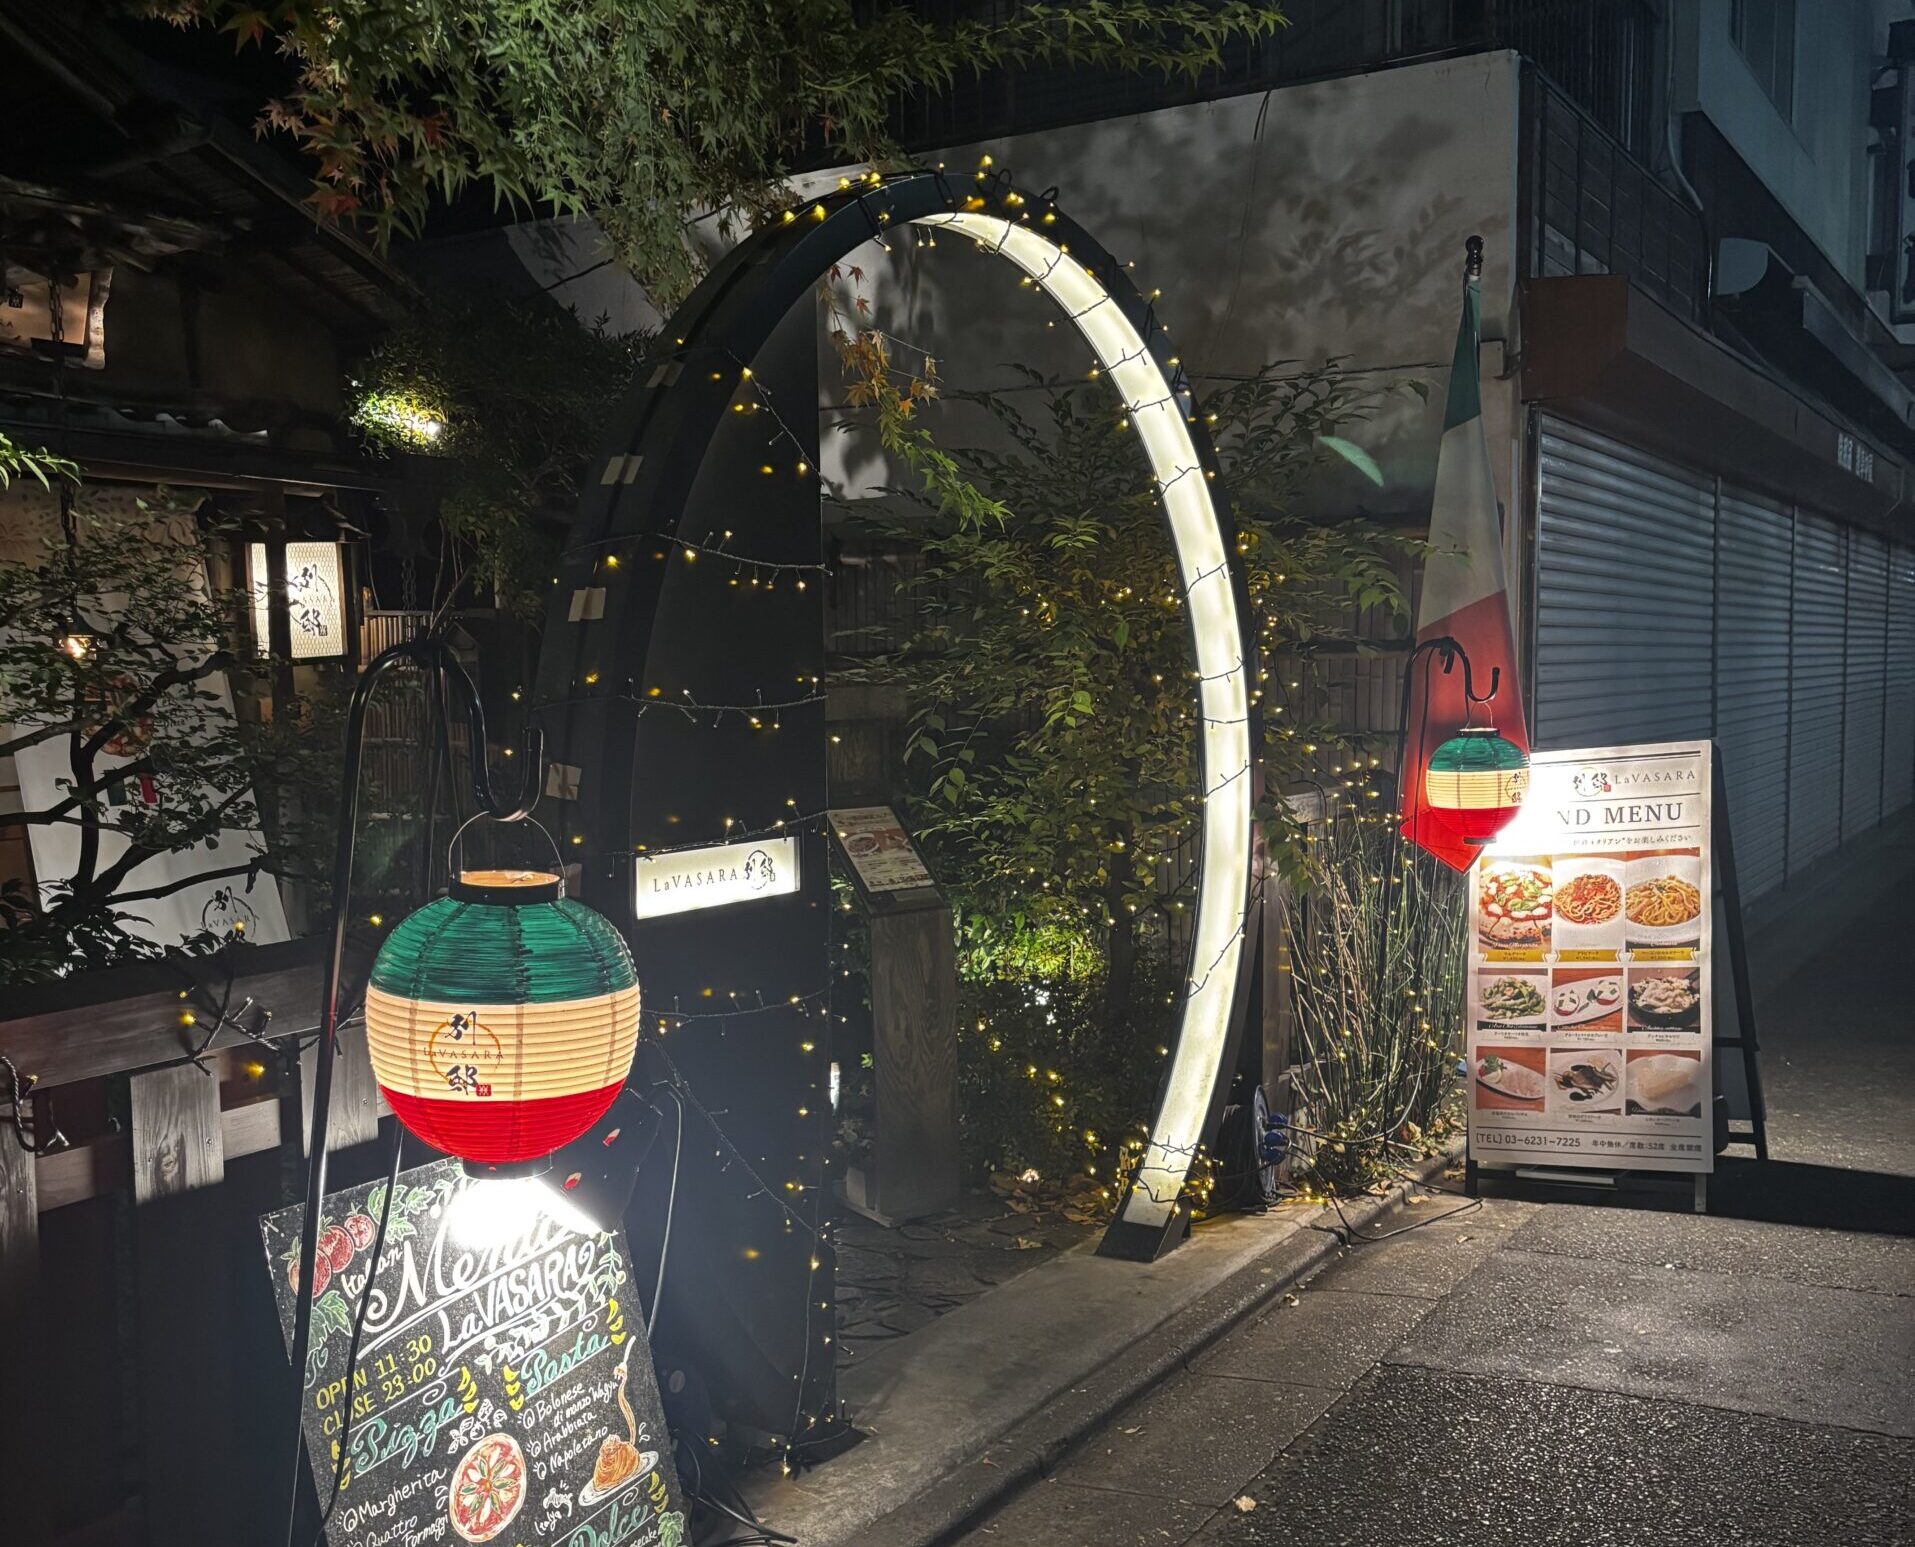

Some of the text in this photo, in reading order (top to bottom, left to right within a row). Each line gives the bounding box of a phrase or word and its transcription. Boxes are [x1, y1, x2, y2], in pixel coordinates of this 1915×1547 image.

[1615, 770, 1696, 785] LaVASARA
[1604, 802, 1683, 824] MENU
[653, 867, 738, 893] LaVASARA
[423, 1047, 504, 1060] LaVASARA
[340, 1247, 403, 1300] Italan
[375, 1335, 432, 1379] 11:30
[520, 1331, 608, 1394] Pasta
[323, 1358, 437, 1436] CLSE 23:00
[535, 1382, 585, 1422] Bolonese
[553, 1381, 618, 1427] di manzo Wagyu
[351, 1397, 462, 1473] Pizza
[543, 1411, 598, 1453] Arabbiata
[550, 1426, 608, 1473] Napoletano
[358, 1467, 448, 1524] Margherita
[366, 1515, 418, 1547] Quattro
[402, 1509, 449, 1547] Formaggi
